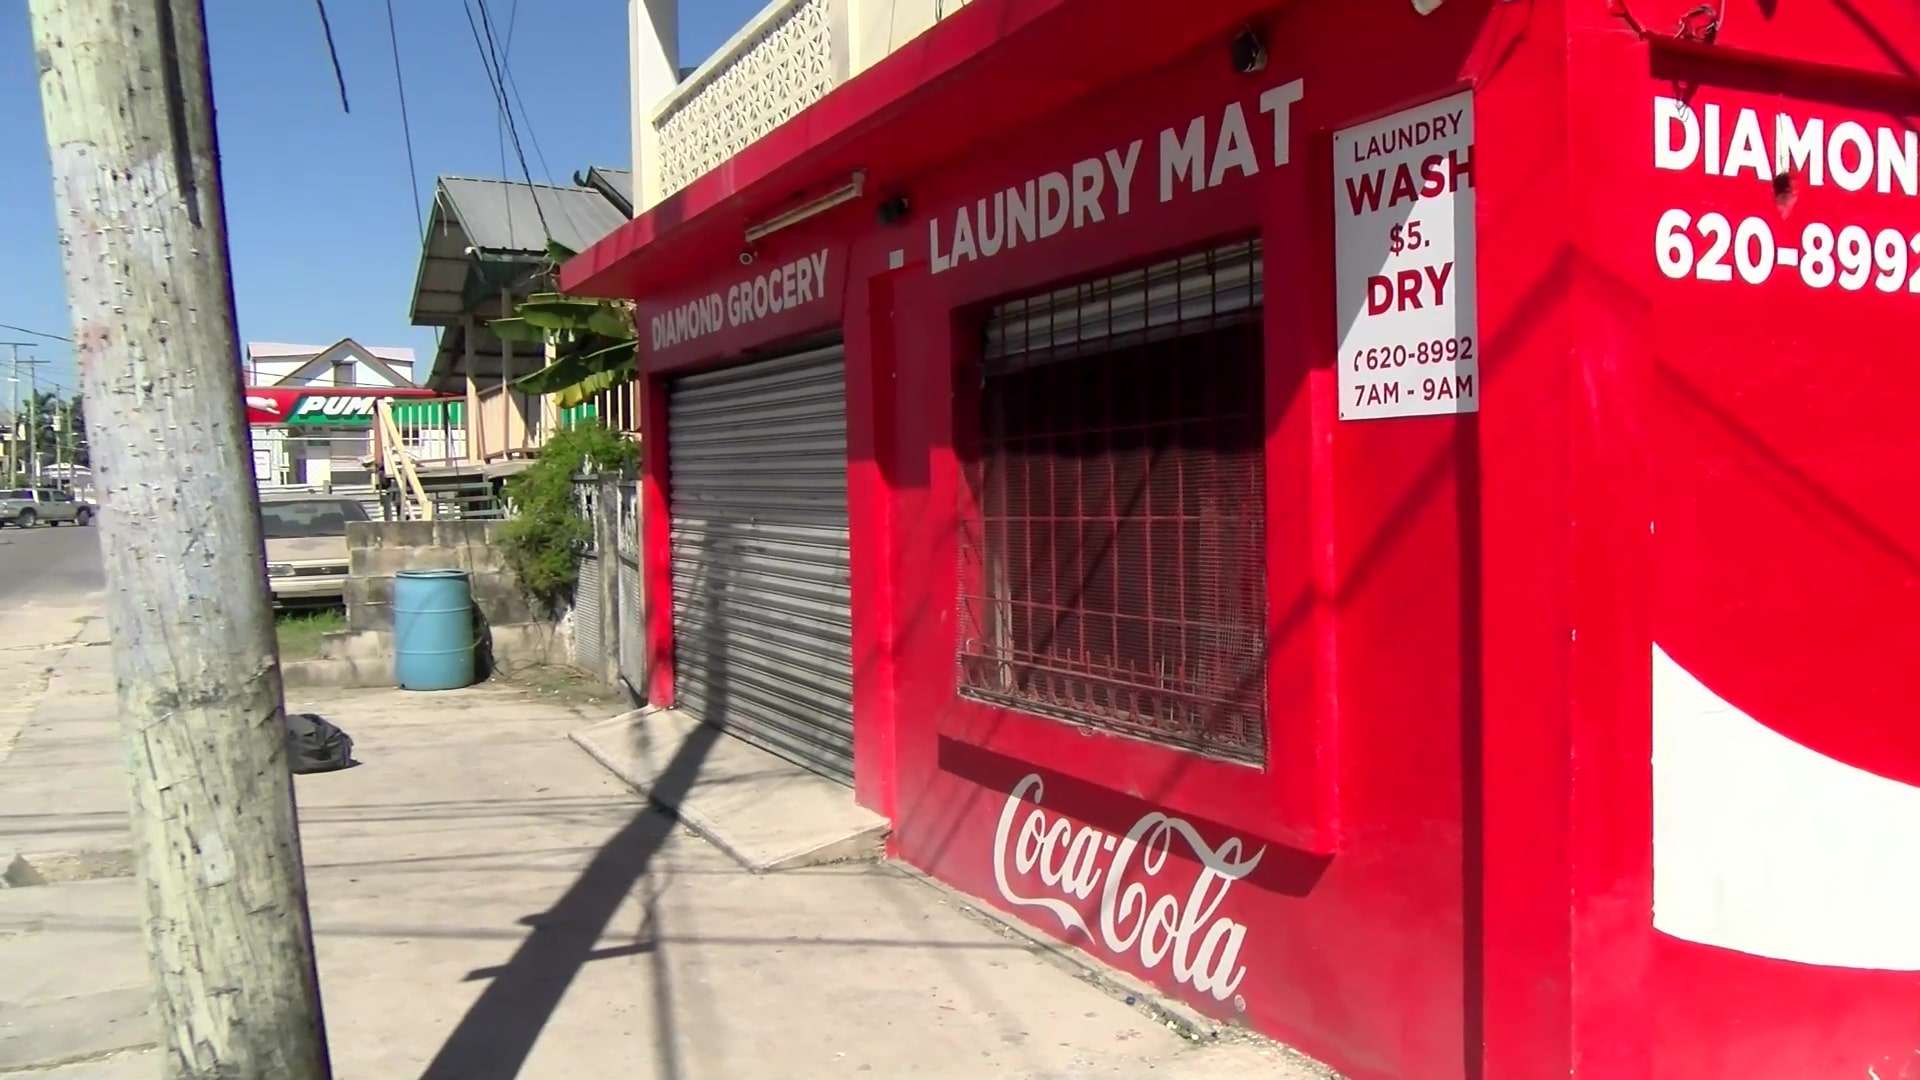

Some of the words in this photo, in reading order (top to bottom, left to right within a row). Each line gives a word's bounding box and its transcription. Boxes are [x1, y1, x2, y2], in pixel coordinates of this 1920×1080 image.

[1354, 110, 1463, 162] LAUNDRY
[1654, 96, 1919, 196] DIAMON
[1346, 144, 1475, 216] WASH
[652, 293, 723, 351] DIAMOND
[727, 248, 829, 327] GROCERY
[929, 139, 1143, 275] LAUNDRY
[1159, 78, 1304, 203] MAT
[1390, 220, 1430, 256] $5.
[1367, 262, 1453, 316] DRY
[1366, 336, 1473, 370] 620-8992
[297, 395, 375, 416] PUM
[1354, 382, 1399, 406] 7AM
[1422, 374, 1474, 401] 9AM
[994, 773, 1267, 1000] Coca-Cola
